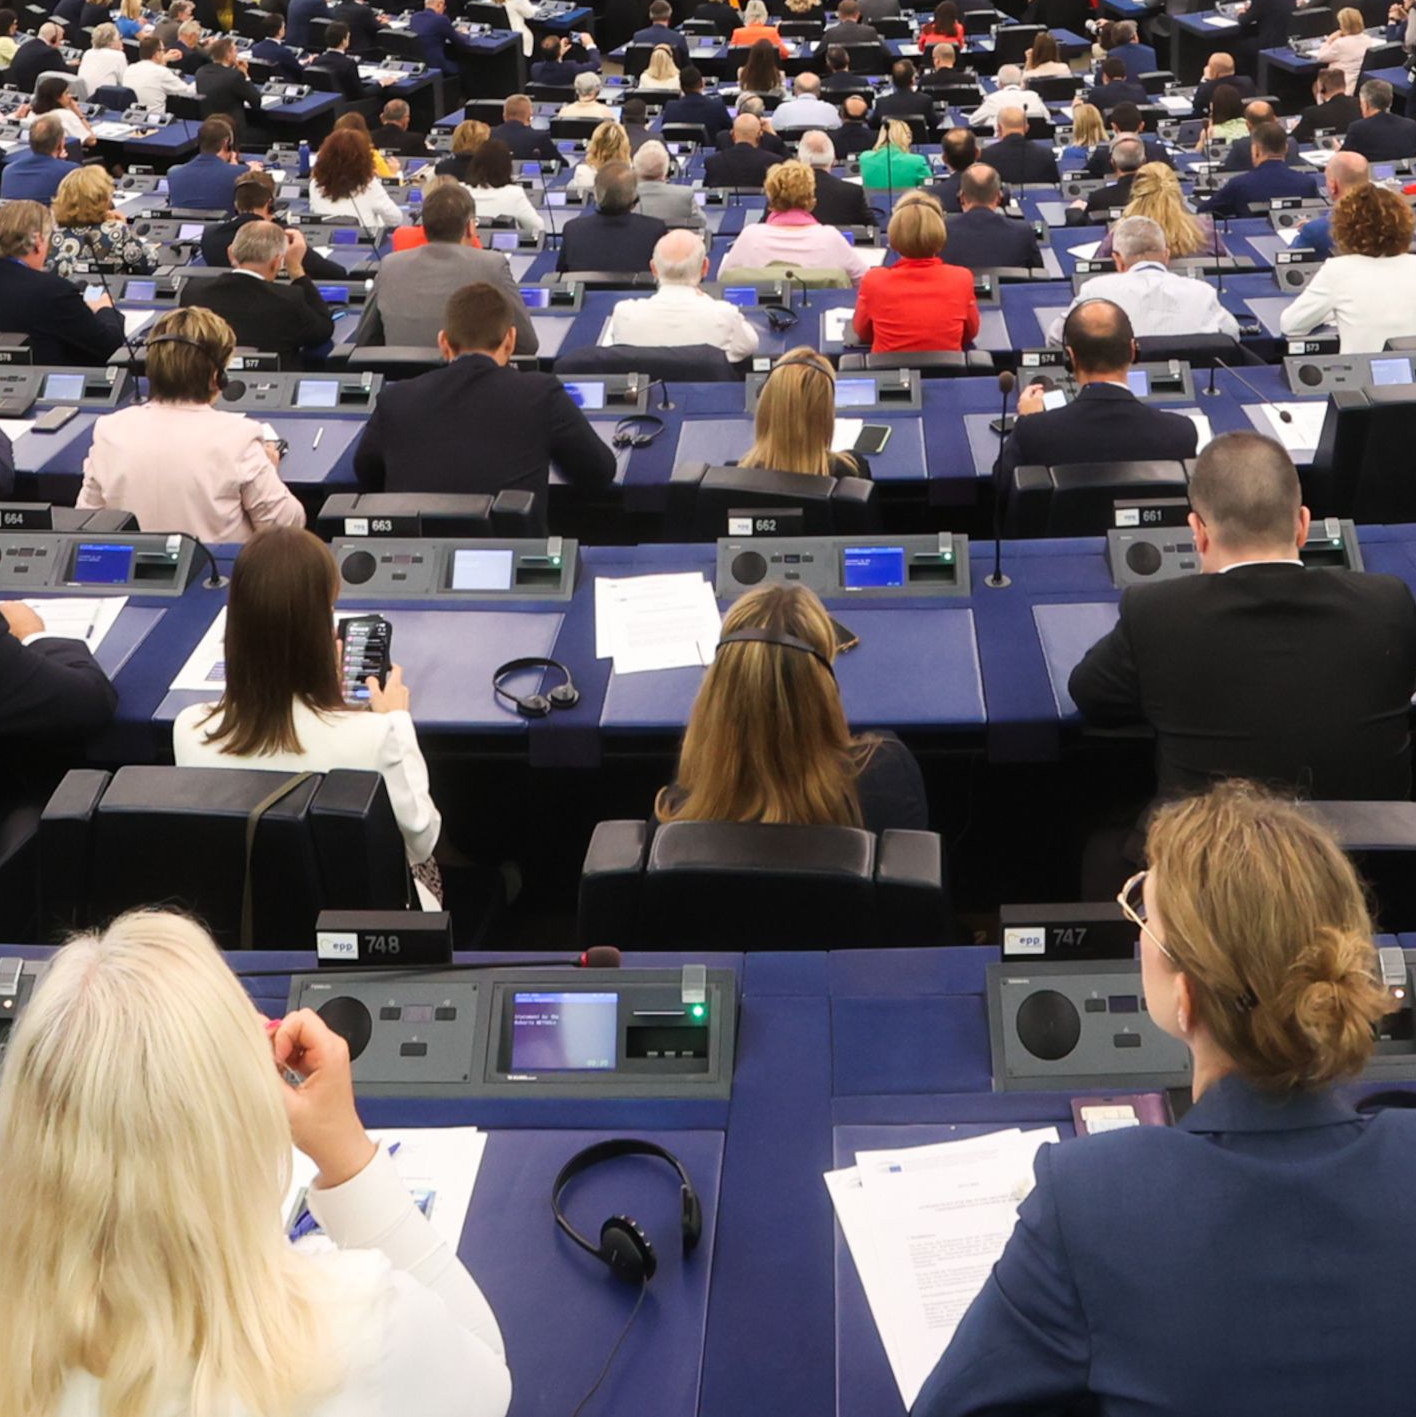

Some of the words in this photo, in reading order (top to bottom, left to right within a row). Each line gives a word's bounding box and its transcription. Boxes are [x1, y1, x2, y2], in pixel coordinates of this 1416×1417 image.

[1306, 343, 1319, 352] 573
[245, 359, 259, 368] 577
[1041, 354, 1055, 363] 574
[4, 512, 23, 525] 664
[1143, 510, 1162, 522] 661
[372, 519, 392, 532] 663
[756, 519, 776, 532] 662
[1019, 935, 1040, 947] epp
[1053, 928, 1086, 946] 747
[332, 941, 353, 953] epp
[364, 935, 401, 955] 748
